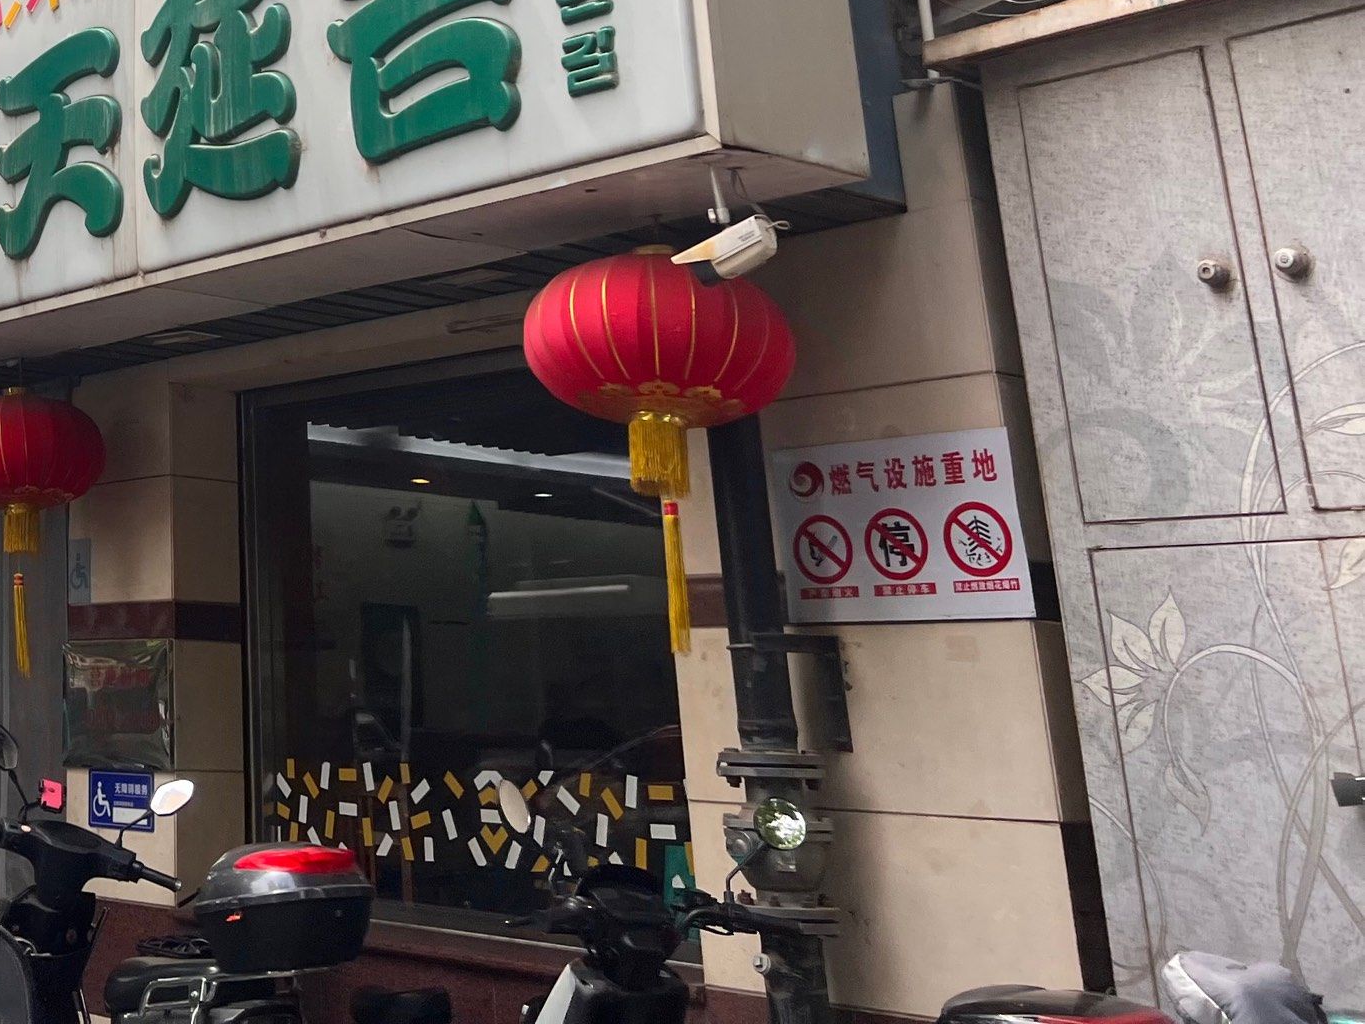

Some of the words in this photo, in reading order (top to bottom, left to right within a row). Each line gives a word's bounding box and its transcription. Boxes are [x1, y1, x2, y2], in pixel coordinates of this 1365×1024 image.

[829, 448, 998, 496] 燃气设施重地
